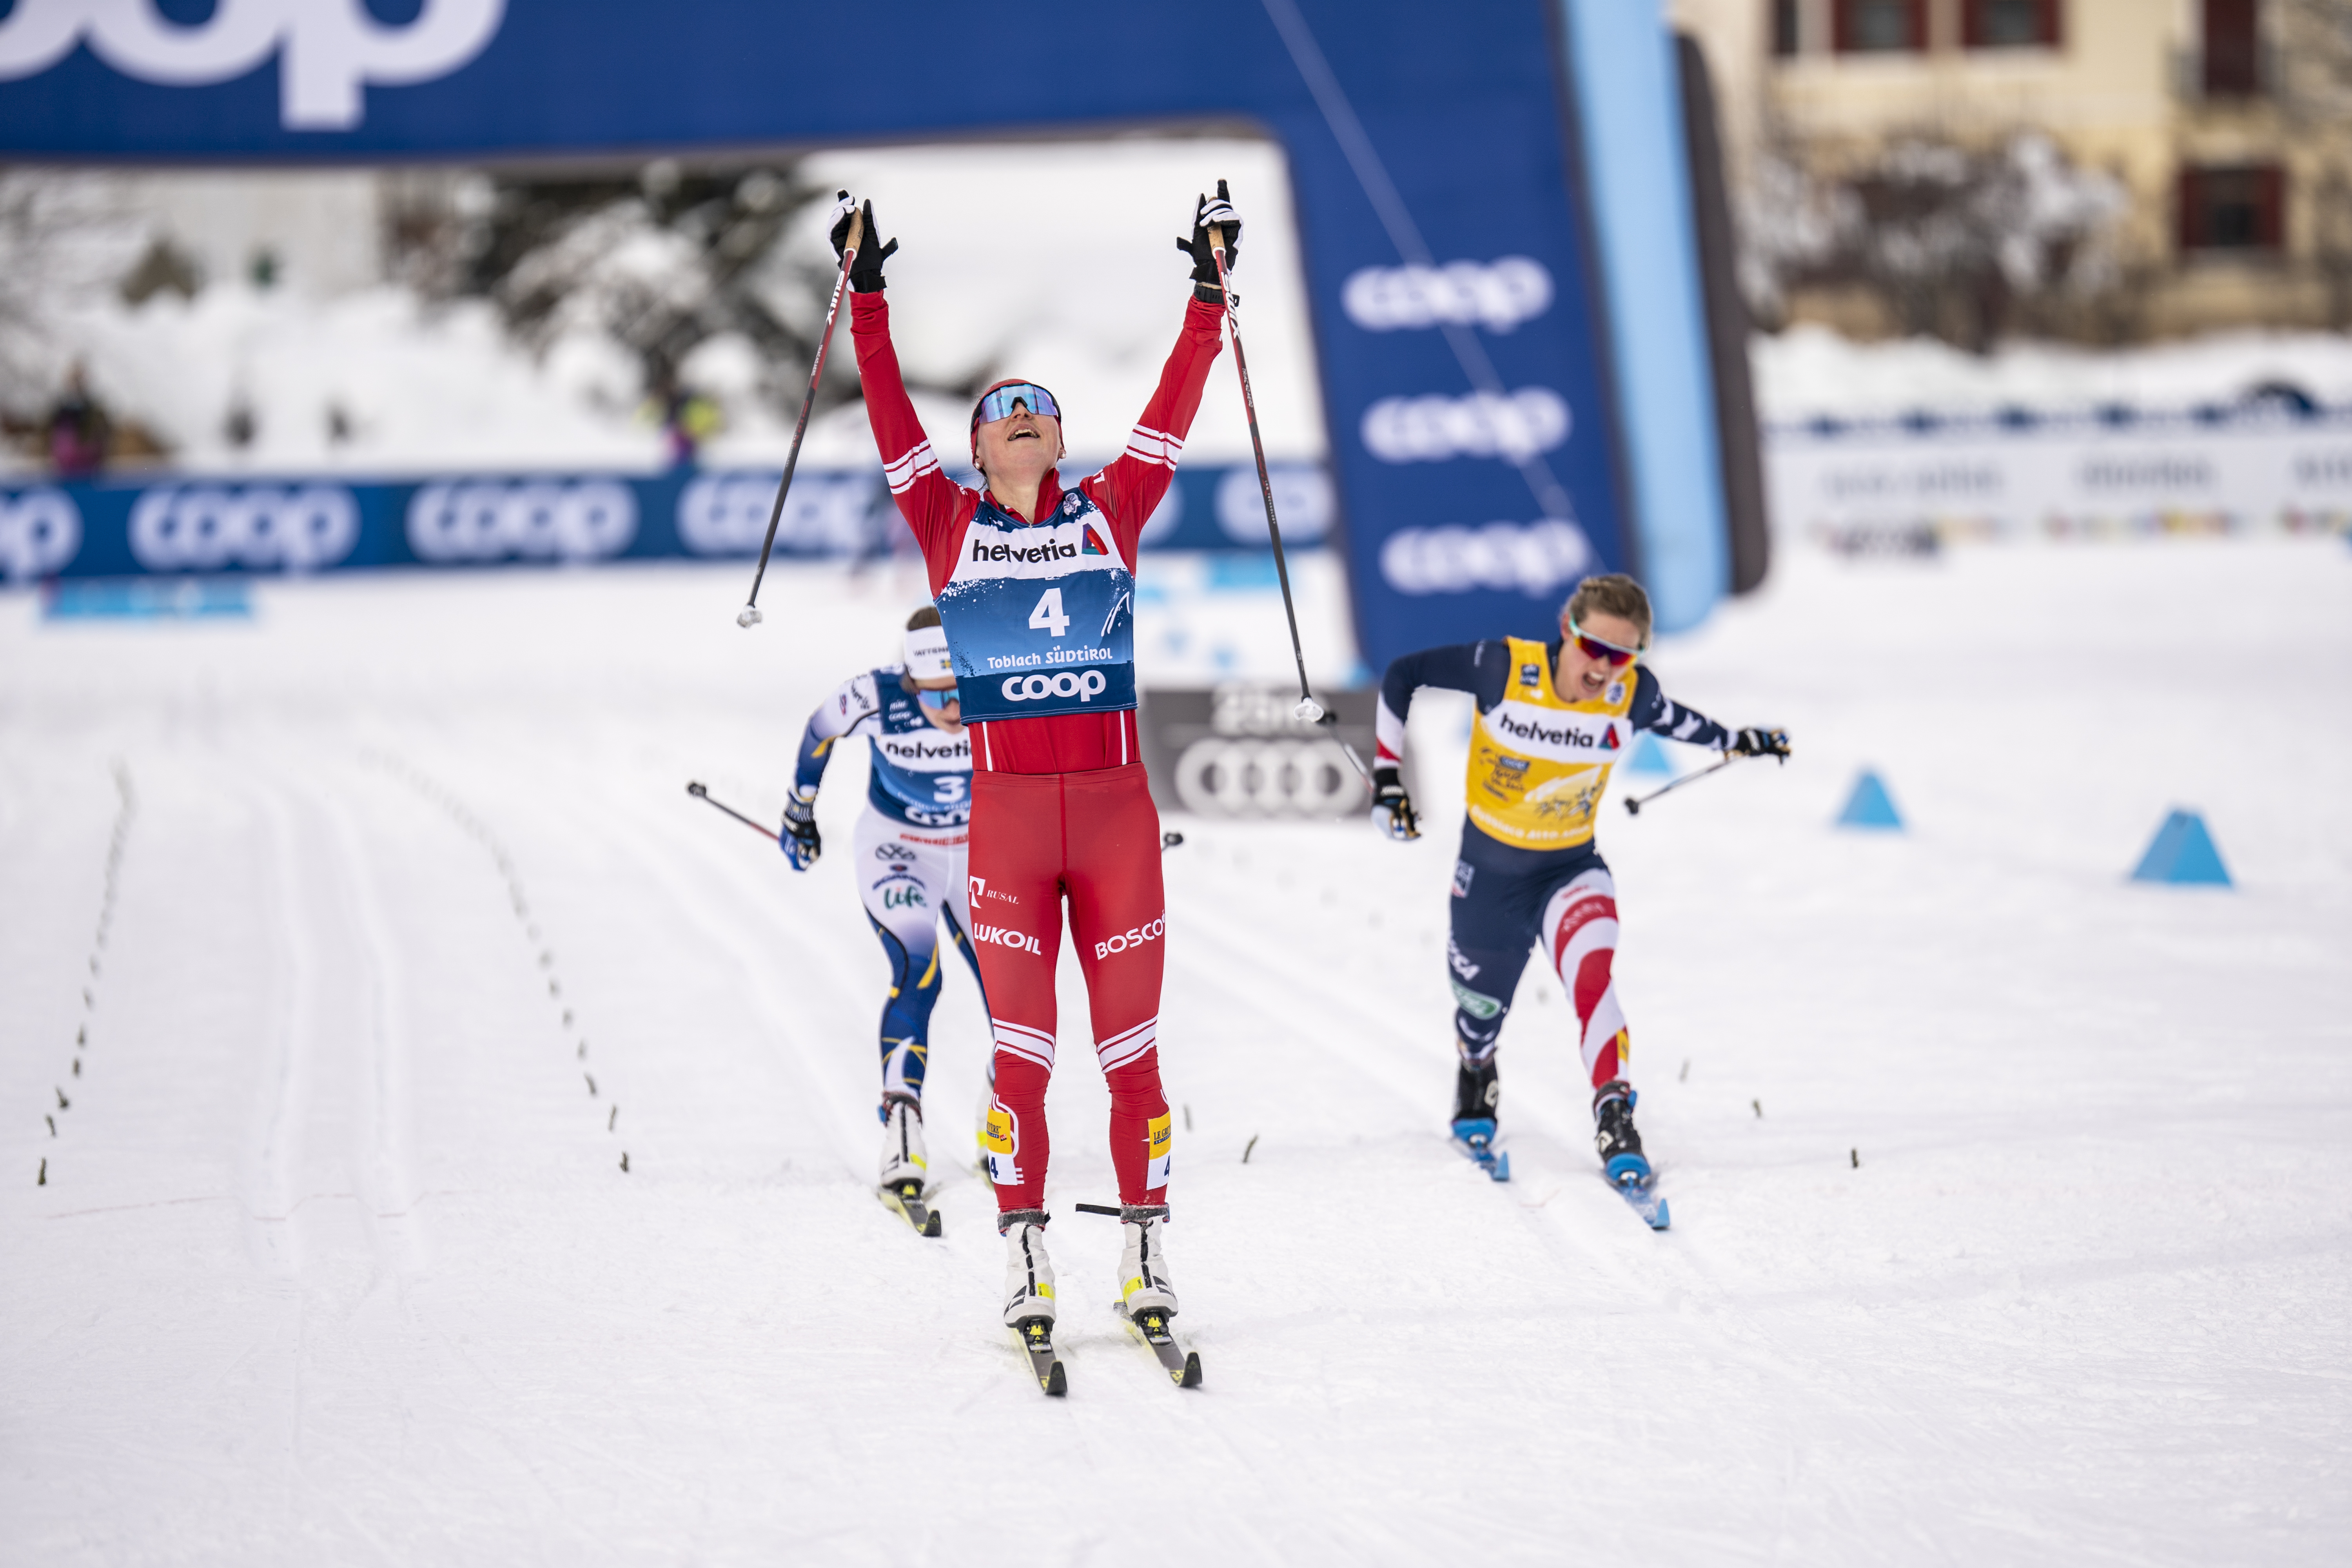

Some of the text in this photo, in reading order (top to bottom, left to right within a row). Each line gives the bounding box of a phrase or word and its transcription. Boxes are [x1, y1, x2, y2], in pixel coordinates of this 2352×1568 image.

[1344, 259, 1551, 332] coop
[1363, 388, 1569, 464] coop
[129, 482, 360, 578] coop
[408, 476, 637, 564] coop
[973, 539, 1077, 563] helvetia
[1382, 521, 1587, 597] coop
[1029, 588, 1070, 637] 4
[987, 654, 1041, 669] Toblach
[1002, 670, 1106, 702] coop
[1499, 713, 1593, 748] helvetia
[934, 777, 965, 803] 3
[987, 890, 1019, 904] RUSAL
[975, 923, 1041, 955] LUKOIL
[1095, 918, 1163, 960] BOSCO
[1154, 1131, 1161, 1140] LE
[990, 1157, 998, 1179] 4
